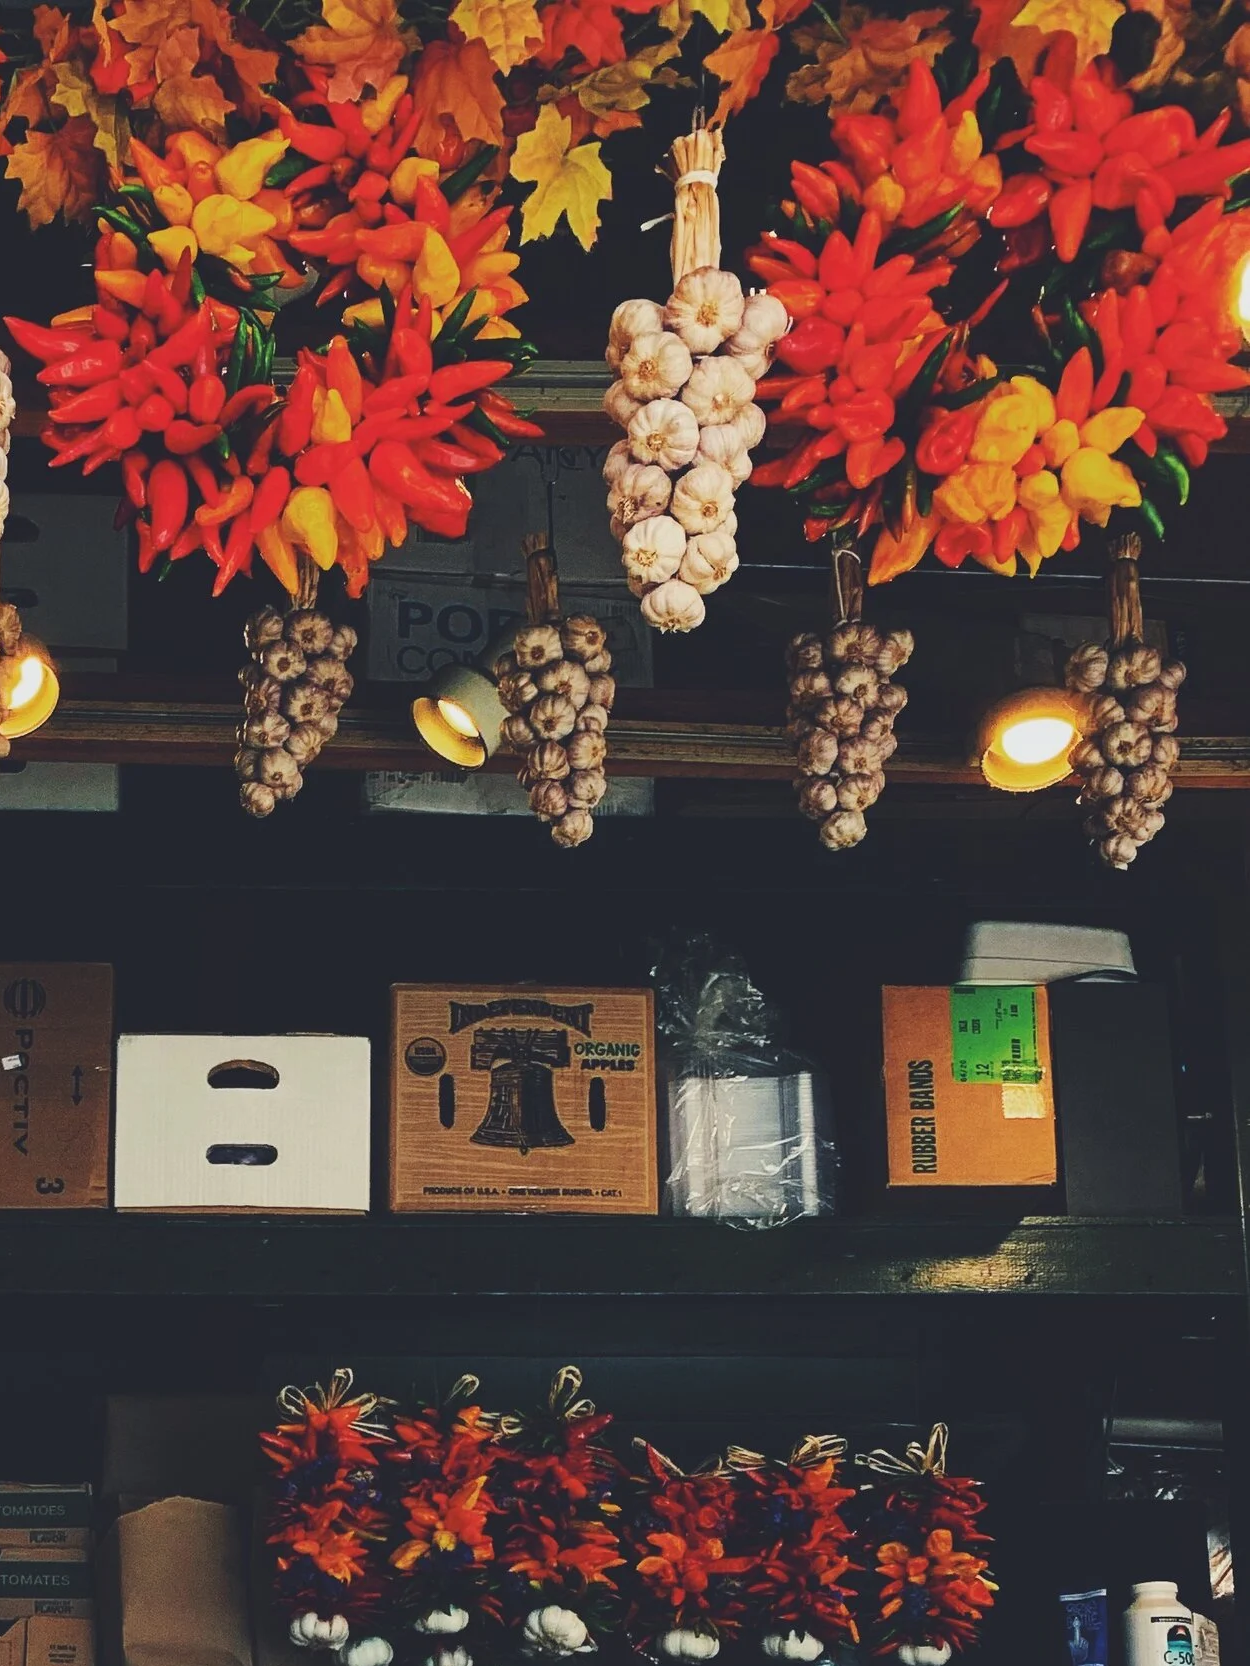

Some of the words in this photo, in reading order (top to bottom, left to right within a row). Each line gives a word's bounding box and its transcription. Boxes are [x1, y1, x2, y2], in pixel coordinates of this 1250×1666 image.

[573, 1042, 640, 1058] ORGANIC
[580, 1059, 636, 1071] APPLES
[908, 1059, 935, 1110] BANDS
[910, 1116, 937, 1174] RUBBER
[36, 1176, 65, 1195] 3
[0, 1574, 70, 1586] TOMATES
